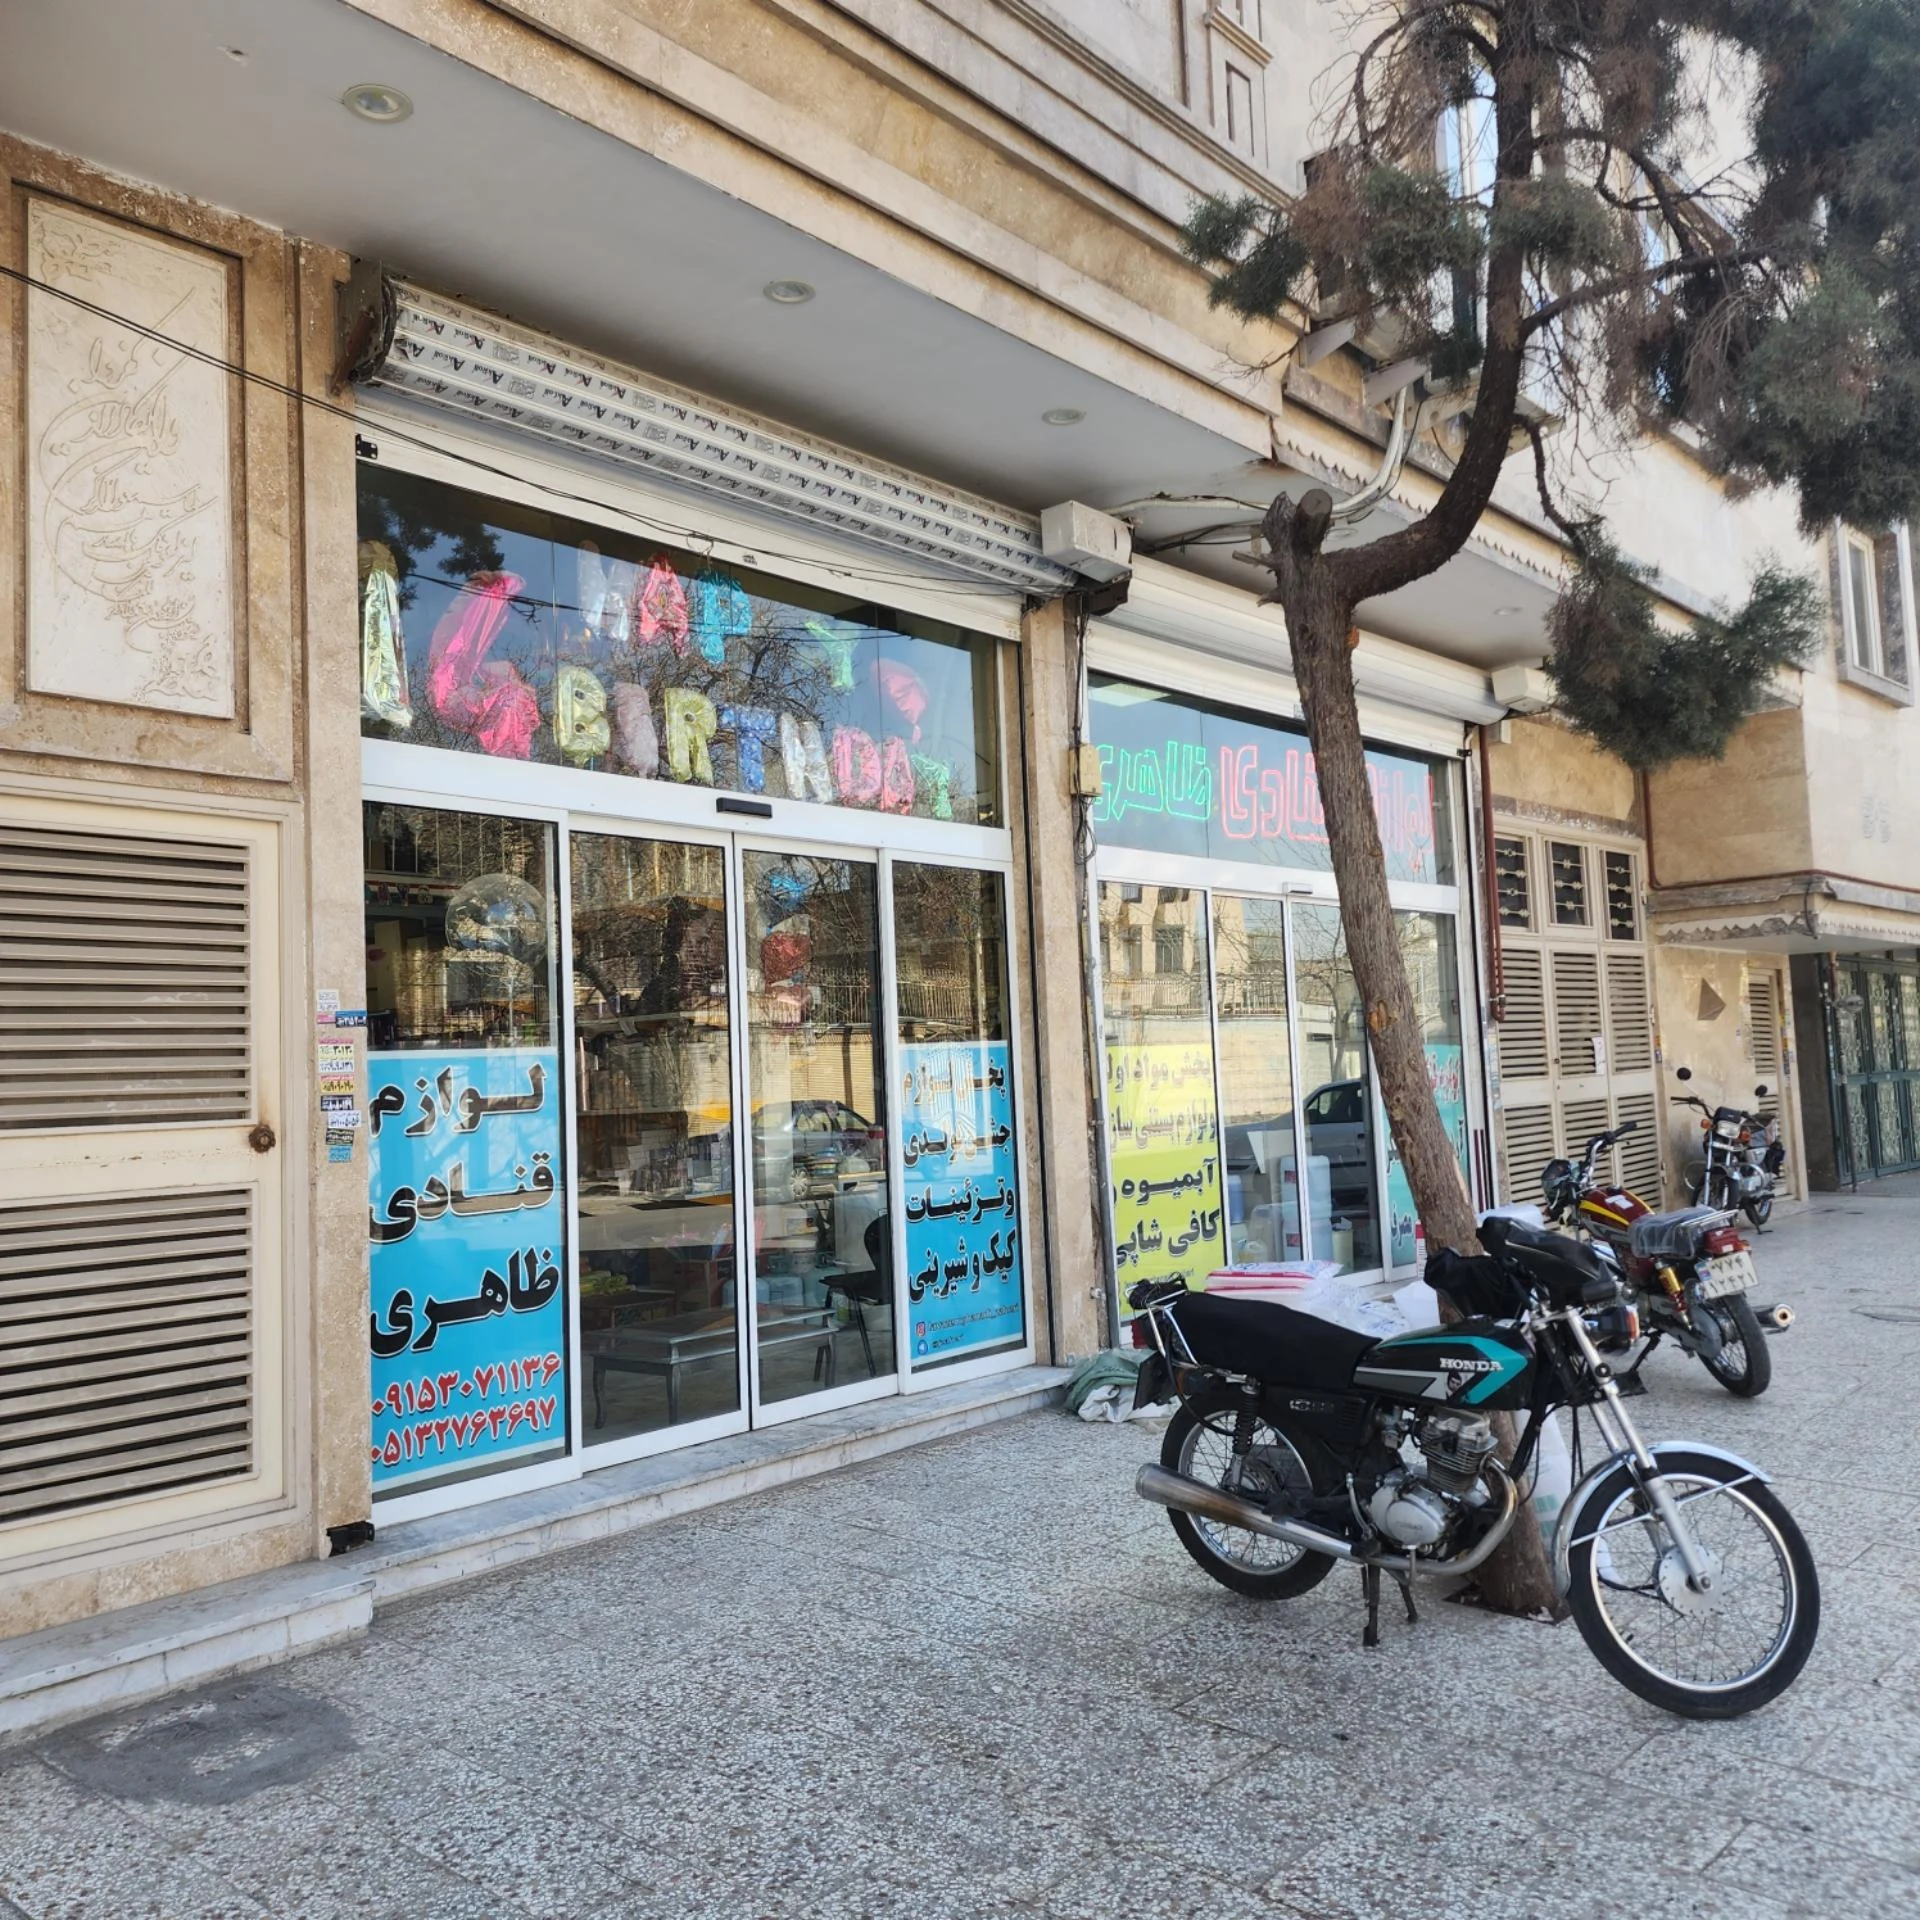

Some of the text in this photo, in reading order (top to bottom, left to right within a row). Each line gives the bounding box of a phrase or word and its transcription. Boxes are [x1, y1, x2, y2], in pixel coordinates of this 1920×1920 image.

[369, 1063, 547, 1138] لوازم
[369, 1152, 555, 1243] قنادی
[1121, 1156, 1217, 1206] آبمیوه
[909, 1228, 1016, 1303] کیک و شیرینی
[1167, 1208, 1221, 1258] کافی
[370, 1245, 560, 1357] ظاهری
[372, 1352, 561, 1416] ۰۹۱۵۳۰۷۱۱۳۶
[1439, 1357, 1505, 1372] HONDA
[371, 1395, 557, 1467] ۰۵۱۳۲۷۶۳۶۹۷
